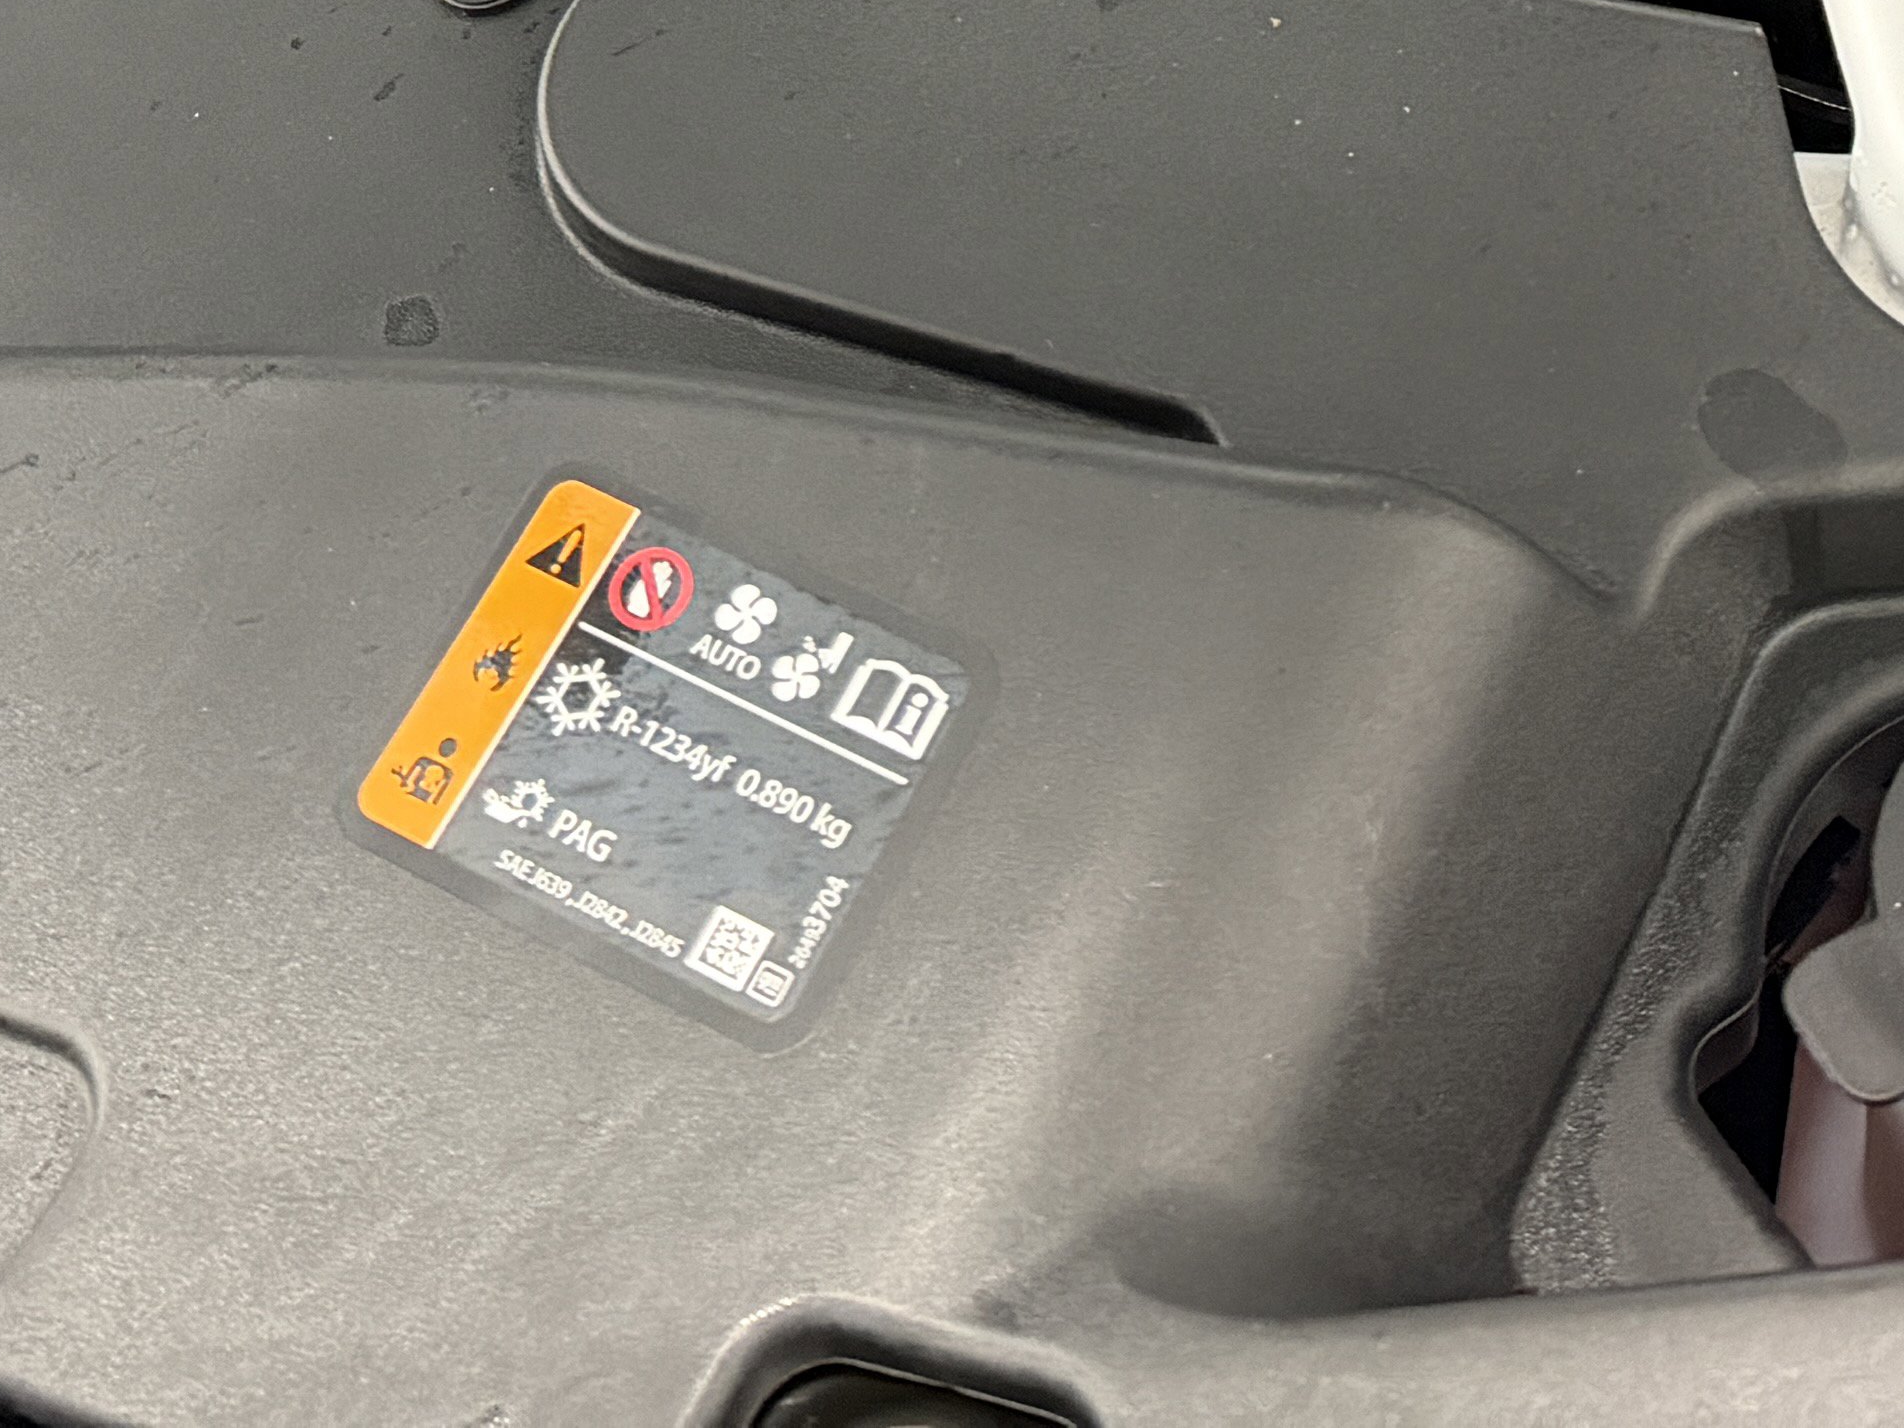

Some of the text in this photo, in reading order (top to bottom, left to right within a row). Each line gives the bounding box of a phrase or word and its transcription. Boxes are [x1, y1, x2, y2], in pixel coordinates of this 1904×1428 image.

[689, 633, 762, 681] AUTO
[609, 705, 854, 850] R-1234yf 0.890 kg
[548, 809, 619, 863] PAG
